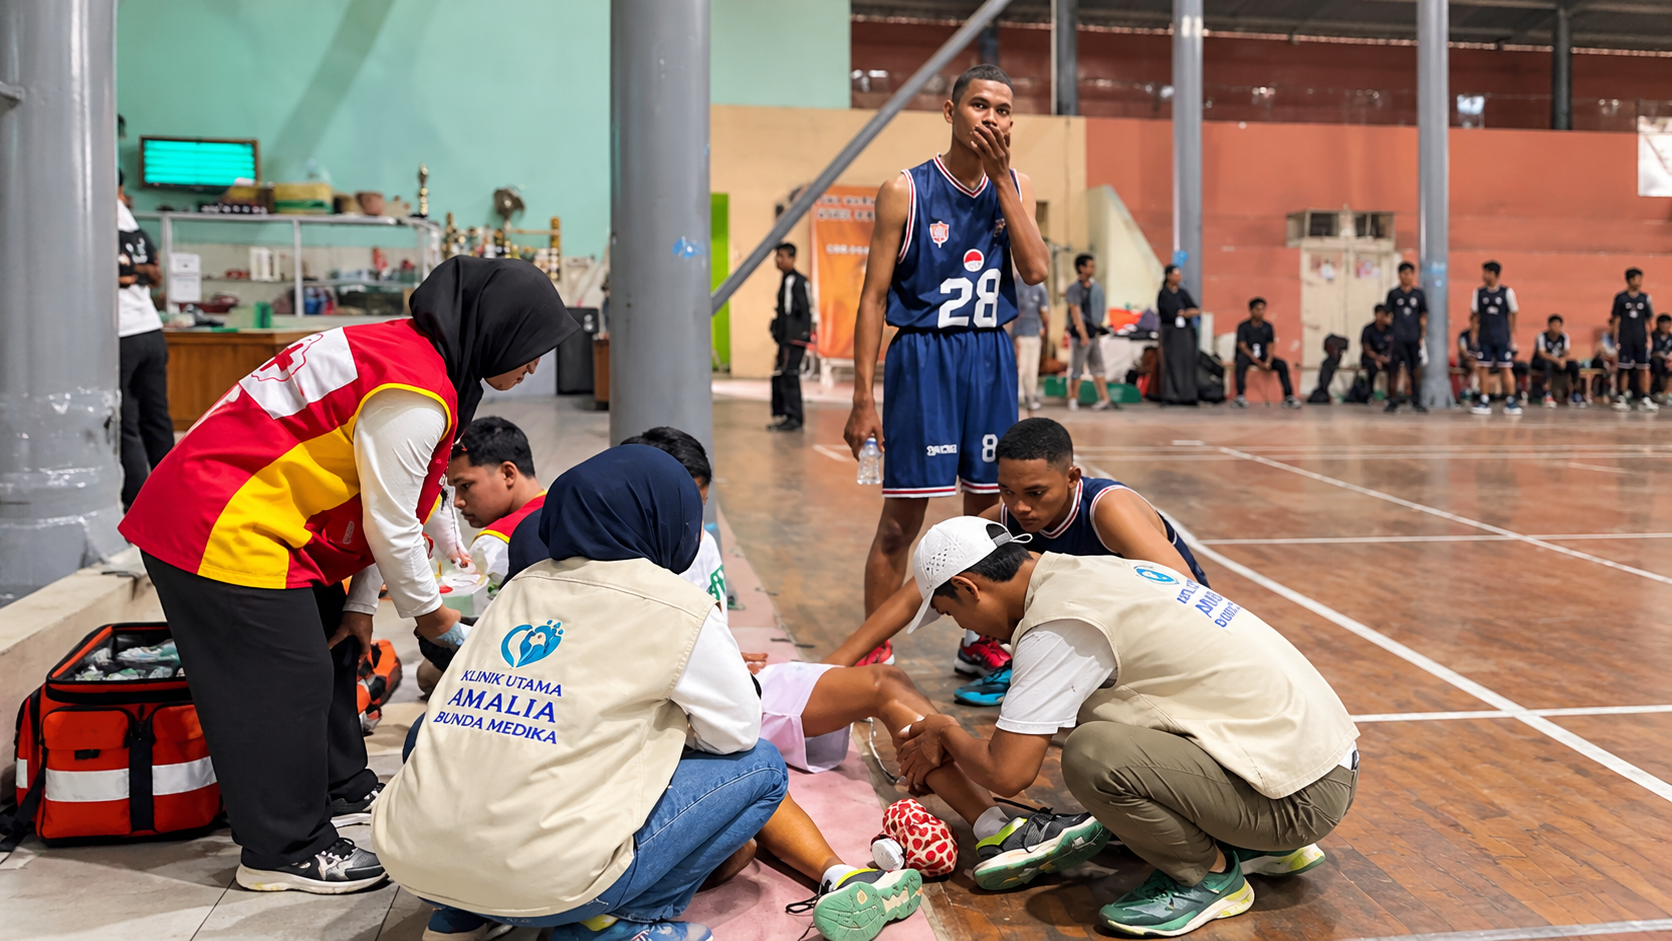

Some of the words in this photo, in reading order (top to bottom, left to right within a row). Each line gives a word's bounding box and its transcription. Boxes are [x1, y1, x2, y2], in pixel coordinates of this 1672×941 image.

[937, 268, 1001, 328] 28
[982, 433, 998, 463] 8
[460, 670, 505, 685] KLINIK
[505, 675, 562, 697] UTAMA
[447, 687, 556, 723] AMALIA
[433, 711, 483, 729] BUNDA
[486, 718, 557, 744] MEDIKA
